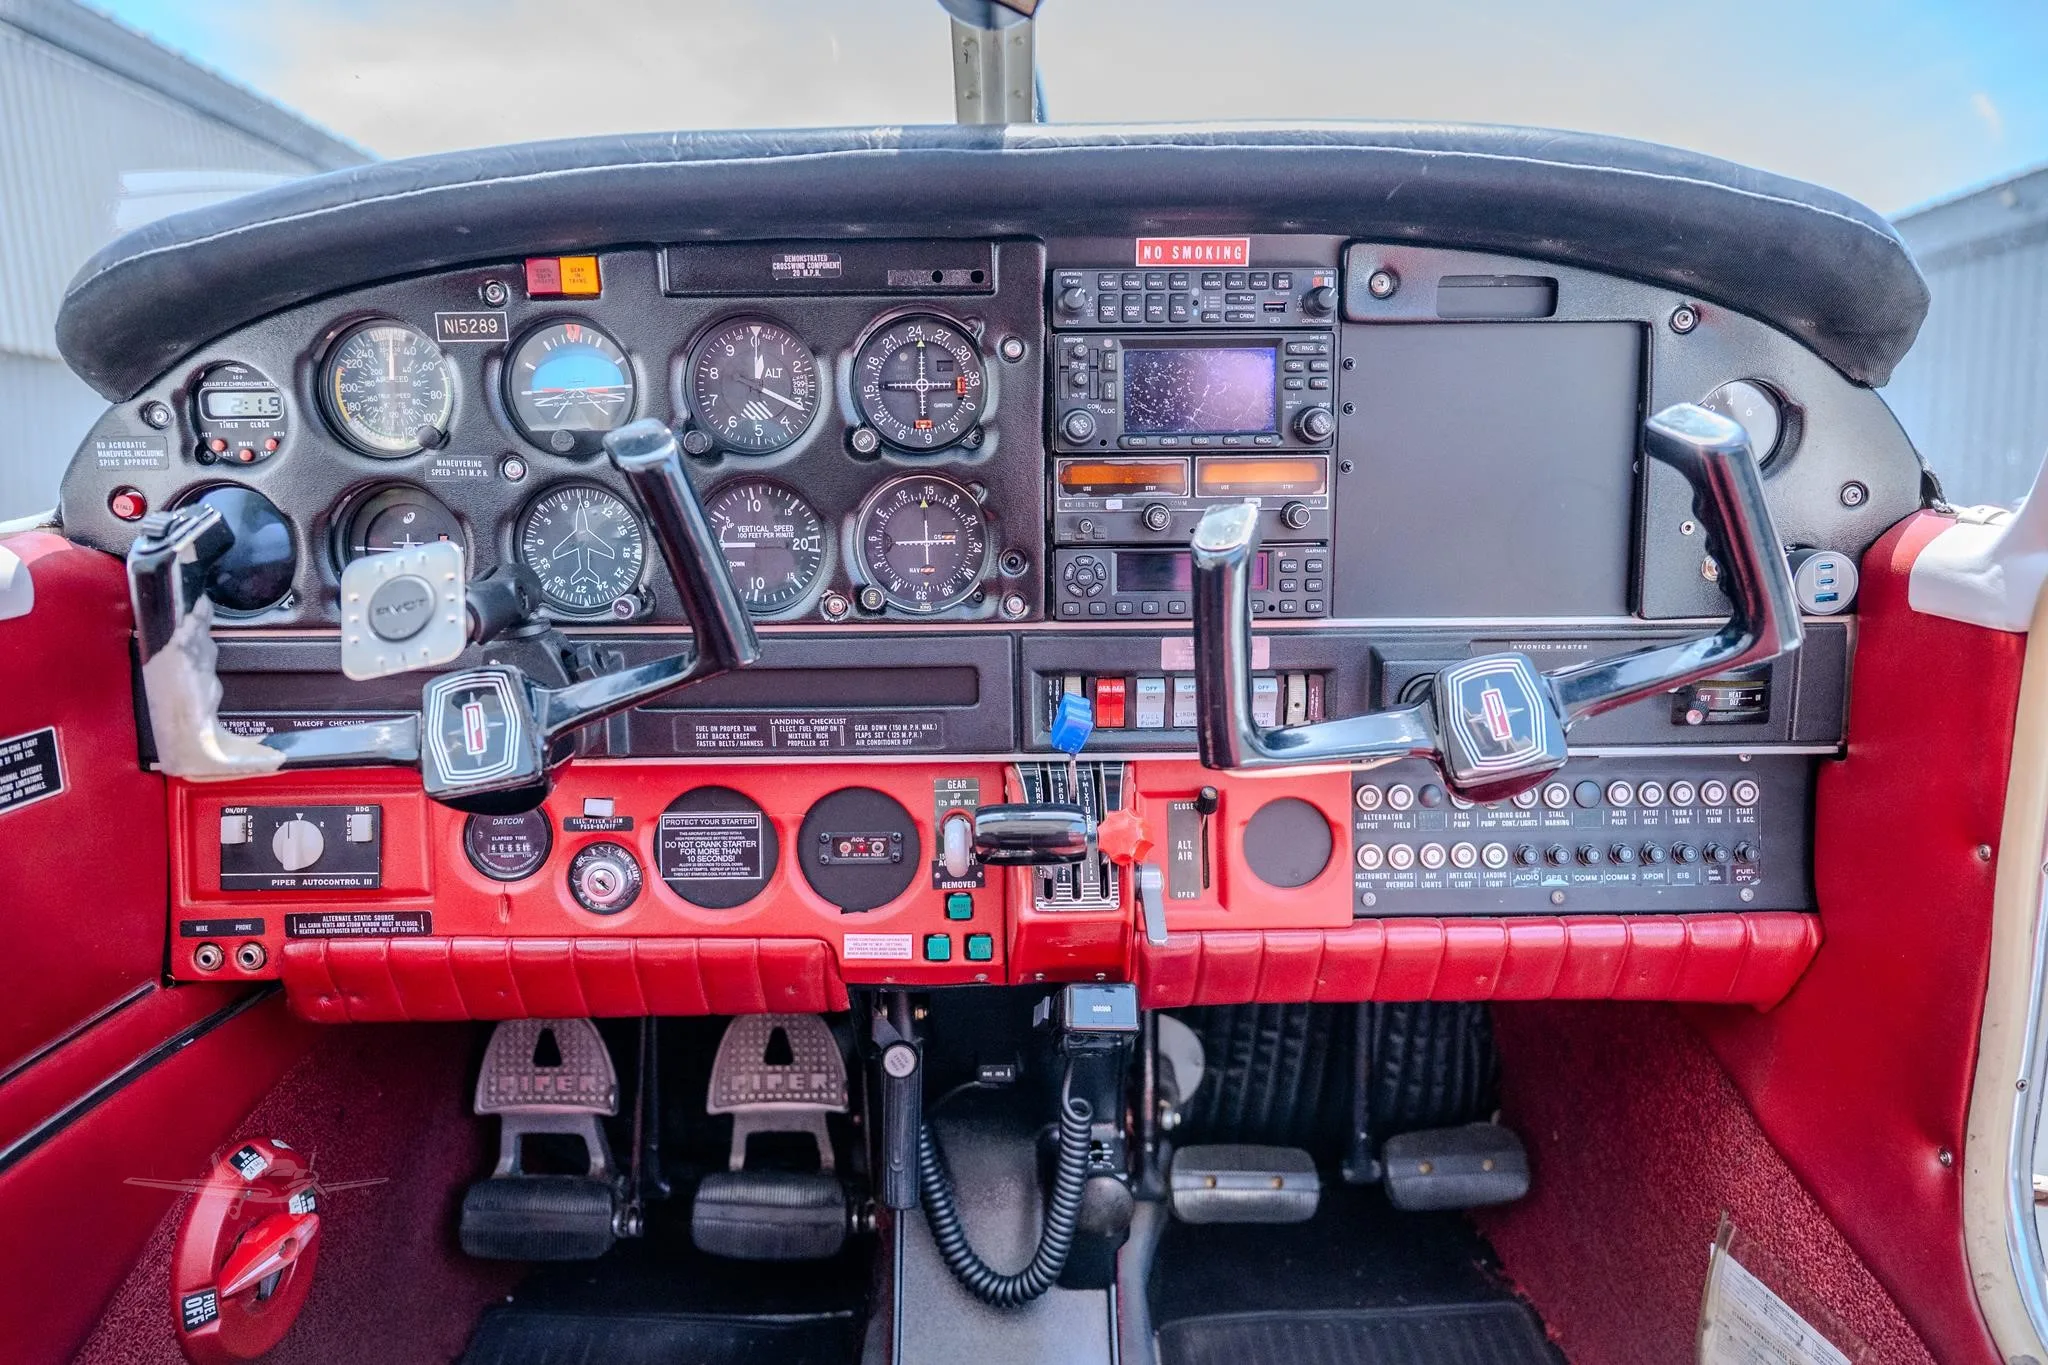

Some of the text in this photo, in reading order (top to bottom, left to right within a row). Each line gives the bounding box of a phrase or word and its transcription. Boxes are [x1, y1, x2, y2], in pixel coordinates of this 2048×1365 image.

[1143, 244, 1242, 260] NO SMOKING
[784, 254, 828, 262] DEMONSTRATED
[772, 261, 840, 270] CROSSWIND COMPONENT
[444, 318, 498, 335] N15289
[907, 324, 923, 338] 24
[934, 328, 951, 343] 27
[882, 334, 897, 349] 21
[957, 345, 971, 361] 30
[347, 359, 362, 369] 220
[422, 362, 435, 371] 60
[866, 356, 880, 371] 18
[764, 368, 783, 378] ALT
[968, 371, 981, 387] 33
[340, 383, 358, 392] 200
[863, 384, 875, 400] 15
[430, 391, 443, 400] 80
[873, 410, 888, 426] 12
[249, 421, 270, 429] CLOCK
[108, 441, 147, 449] ACROBATIC
[436, 459, 482, 468] MANEUVERING
[431, 468, 451, 477] SPEED
[924, 485, 934, 495] 15
[747, 499, 761, 513] 10
[737, 524, 794, 533] VERTICAL SPEED
[792, 537, 809, 550] 20
[750, 577, 765, 590] 10
[947, 780, 967, 789] GEAR
[953, 792, 961, 800] UP
[1487, 811, 1531, 819] LANDING GEAR
[1548, 810, 1565, 818] STALL
[1642, 809, 1659, 817] PITOT
[1705, 808, 1723, 816] PITCH
[1736, 807, 1754, 815] START
[1363, 813, 1403, 821] ALTERNATOR
[1454, 812, 1470, 820] FUEL
[1707, 816, 1722, 824] TRIM
[492, 817, 525, 825] DATCON
[1544, 818, 1570, 826] WARNING
[1611, 818, 1628, 826] PILOT
[1643, 817, 1658, 825] HEAT
[1675, 817, 1691, 825] BANK
[1356, 822, 1379, 830] OUTPUT
[665, 841, 677, 849] DO
[678, 841, 694, 849] NOT
[722, 840, 757, 848] STARTER
[680, 848, 696, 856] FOR
[1177, 851, 1193, 861] AIR
[687, 855, 736, 863] 10 SECONDS!
[1355, 872, 1414, 880] INSTRUMENT LIGHTS
[1425, 872, 1437, 880] NAV
[1483, 871, 1507, 879] LANDING
[1515, 873, 1540, 881] AUDIO
[1574, 874, 1598, 882] COMM
[302, 878, 361, 886] AUTOCONTROL
[941, 880, 977, 889] REMOVED
[1355, 881, 1373, 889] PANEL
[1420, 881, 1443, 889] LIGHTS
[1485, 880, 1503, 888] LIGHT
[235, 923, 252, 931] PHONE
[498, 1075, 596, 1092] PIPER
[731, 1073, 830, 1091] PIPER
[184, 1296, 204, 1326] OFF
[202, 1293, 218, 1320] FUEL
